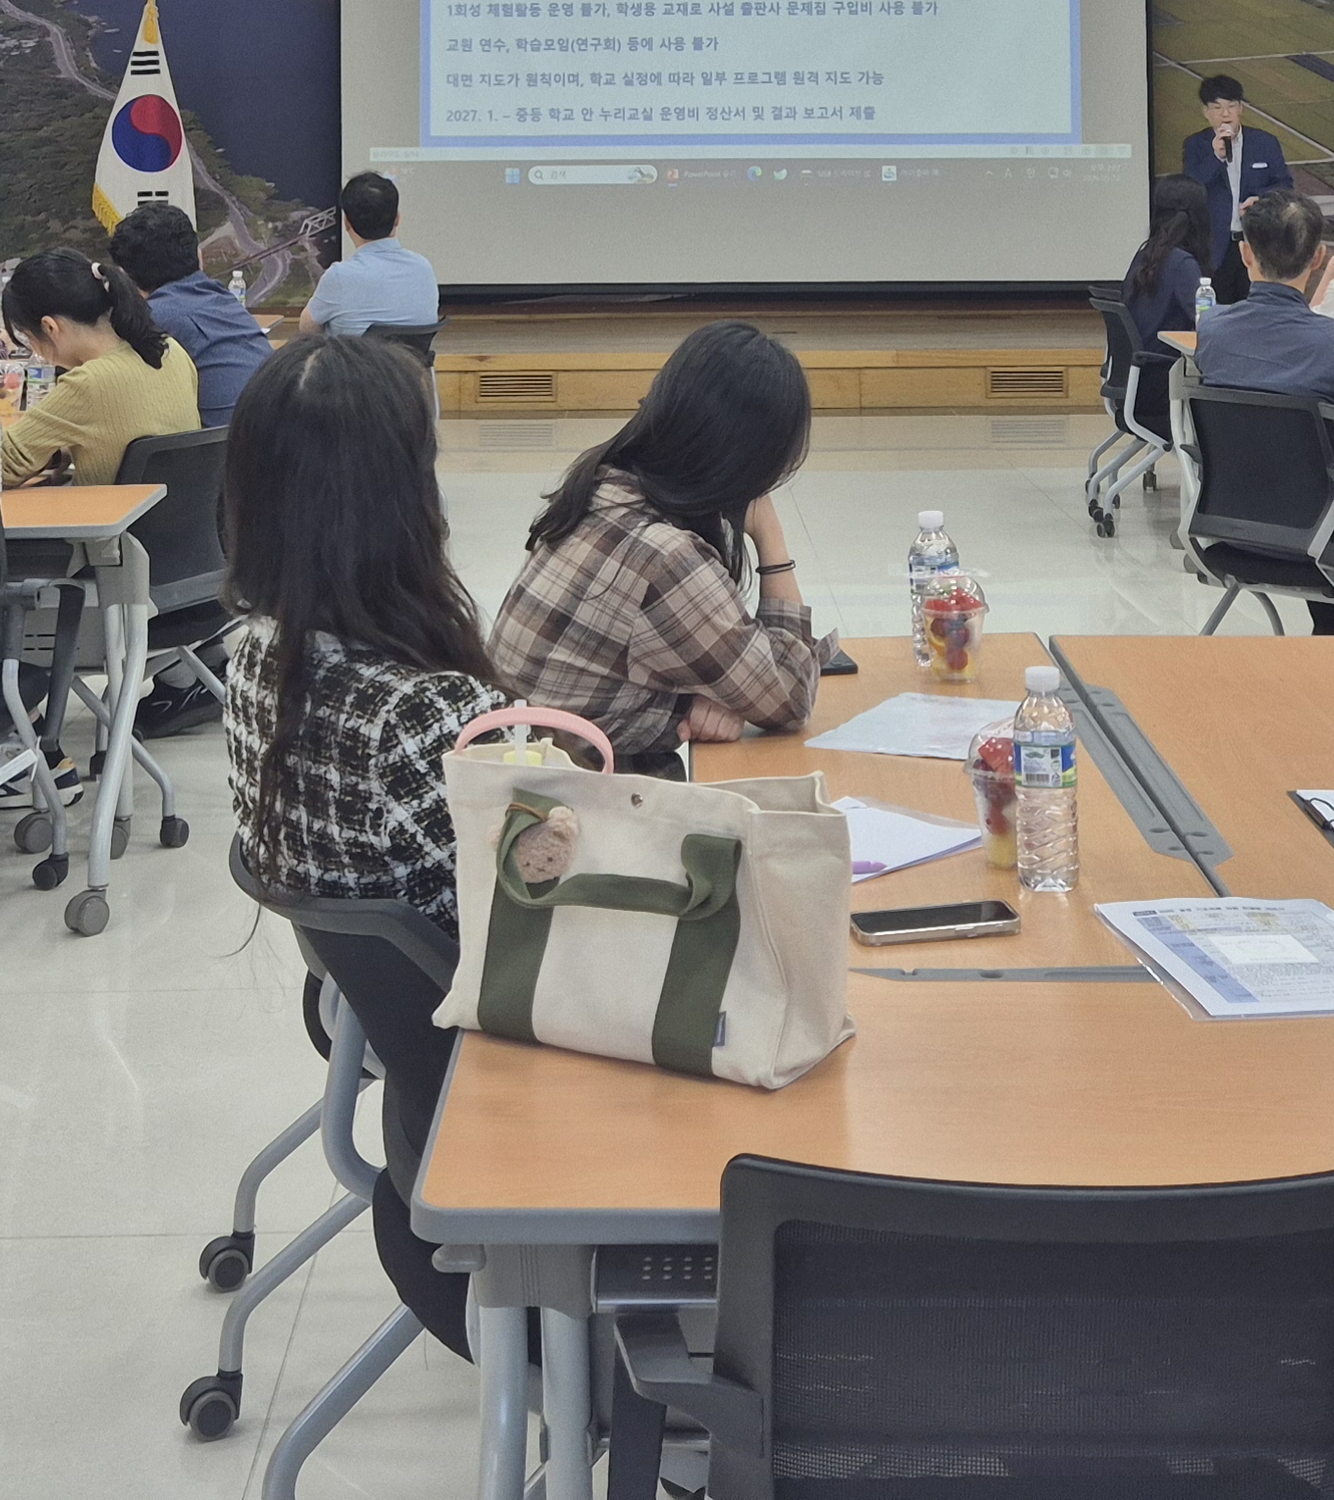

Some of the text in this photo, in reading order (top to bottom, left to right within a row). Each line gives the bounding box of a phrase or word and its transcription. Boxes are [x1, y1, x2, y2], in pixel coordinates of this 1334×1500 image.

[447, 3, 481, 18] 1회성
[487, 2, 542, 18] 체험활동
[547, 2, 574, 18] 운영
[615, 1, 657, 17] 학생용
[661, 1, 703, 17] 교재로
[708, 1, 735, 17] 사설
[786, 0, 827, 16] 문제집
[832, 0, 873, 16] 구입비
[878, 0, 905, 16] 사용
[446, 38, 473, 53] 교원
[479, 37, 510, 54] 연수,
[626, 36, 654, 52] 등에
[659, 36, 686, 52] 사용
[446, 70, 885, 88] 대면 지도가 원칙이며, 학교 실정에 따라 일부 프로그램 원격 지도 가능
[446, 108, 482, 123] 2027.
[487, 108, 500, 122] 1.
[515, 107, 542, 123] 중등
[548, 107, 575, 122] 학교
[580, 107, 594, 122] 안
[599, 107, 653, 122] 누리교실
[659, 106, 700, 122] 운영비
[706, 106, 746, 121] 정산서
[752, 106, 764, 121] 및
[771, 106, 798, 121] 결과
[803, 105, 843, 120] 보고서
[849, 105, 877, 121] 제출
